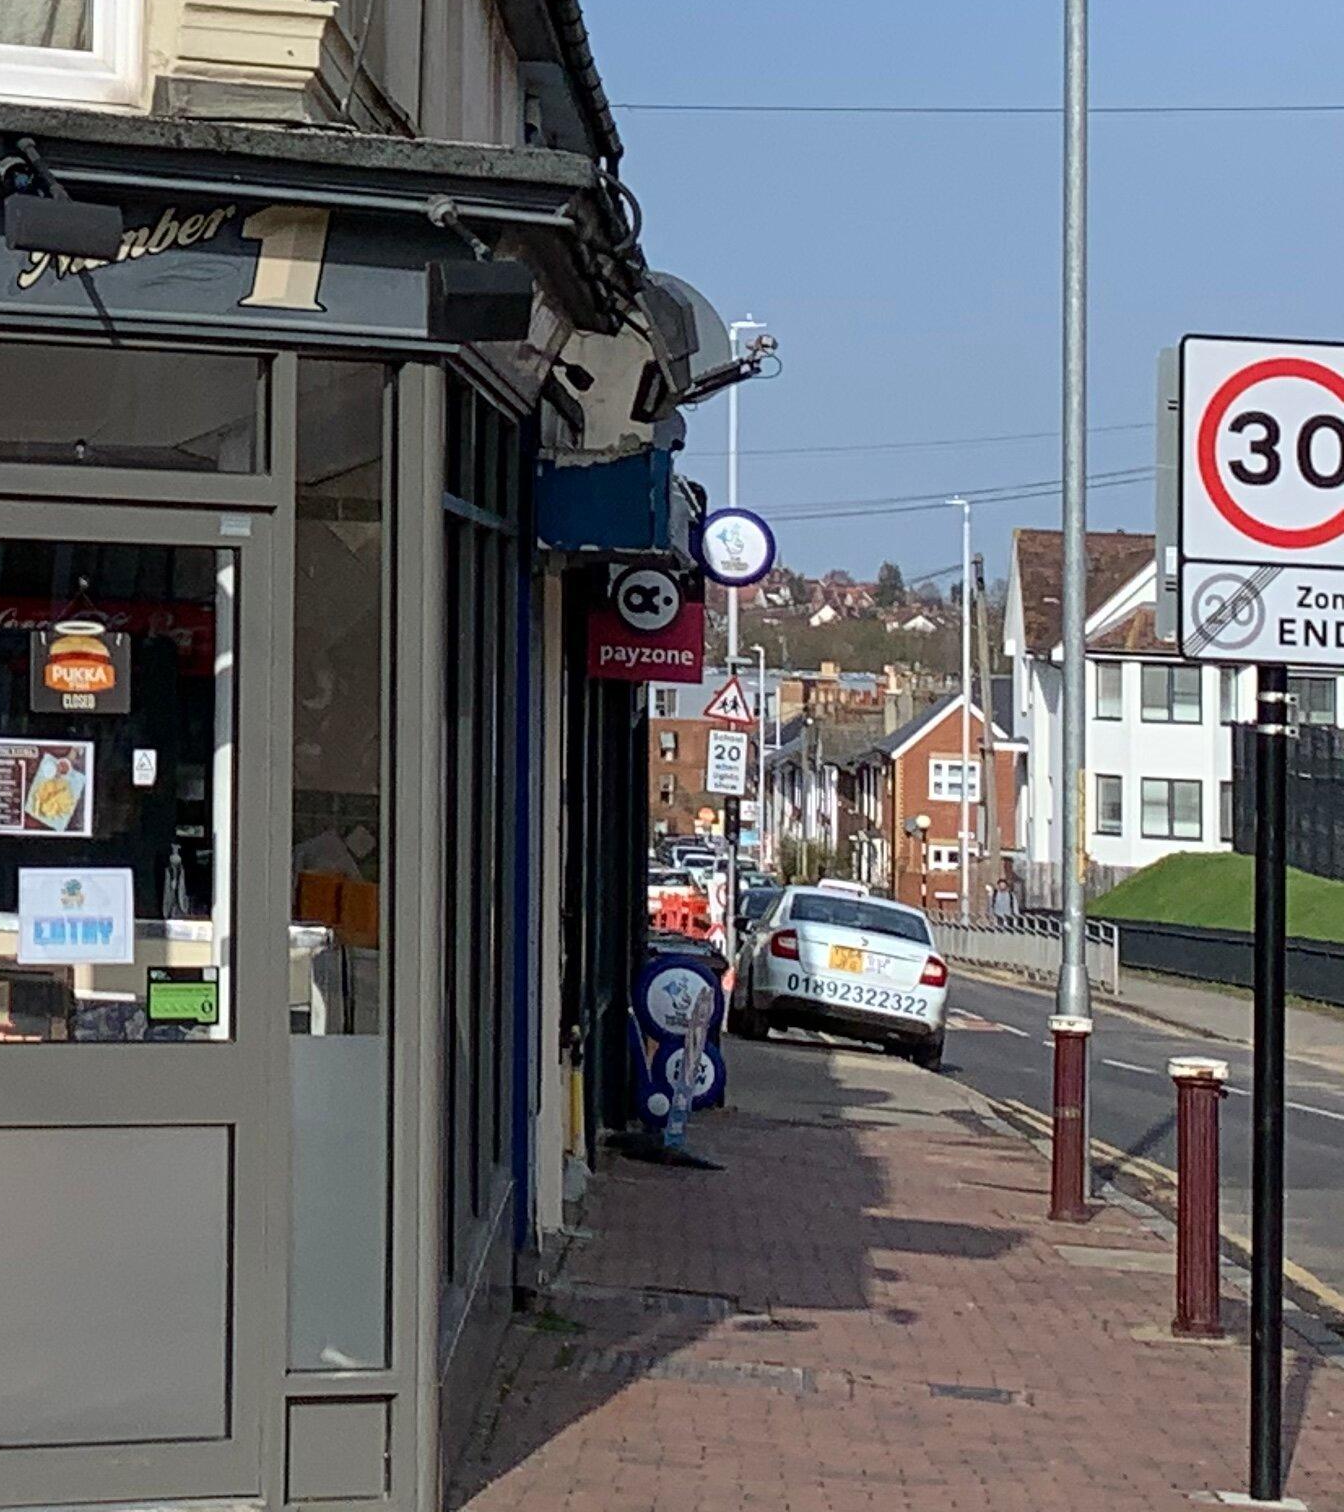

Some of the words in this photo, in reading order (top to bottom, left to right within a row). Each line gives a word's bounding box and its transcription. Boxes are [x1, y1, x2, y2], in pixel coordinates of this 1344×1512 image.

[238, 203, 329, 312] 1
[1228, 410, 1344, 489] 30
[599, 644, 695, 667] payzone
[52, 665, 108, 684] PUKKA
[714, 744, 741, 761] 20
[786, 973, 928, 1017] 01892322322
